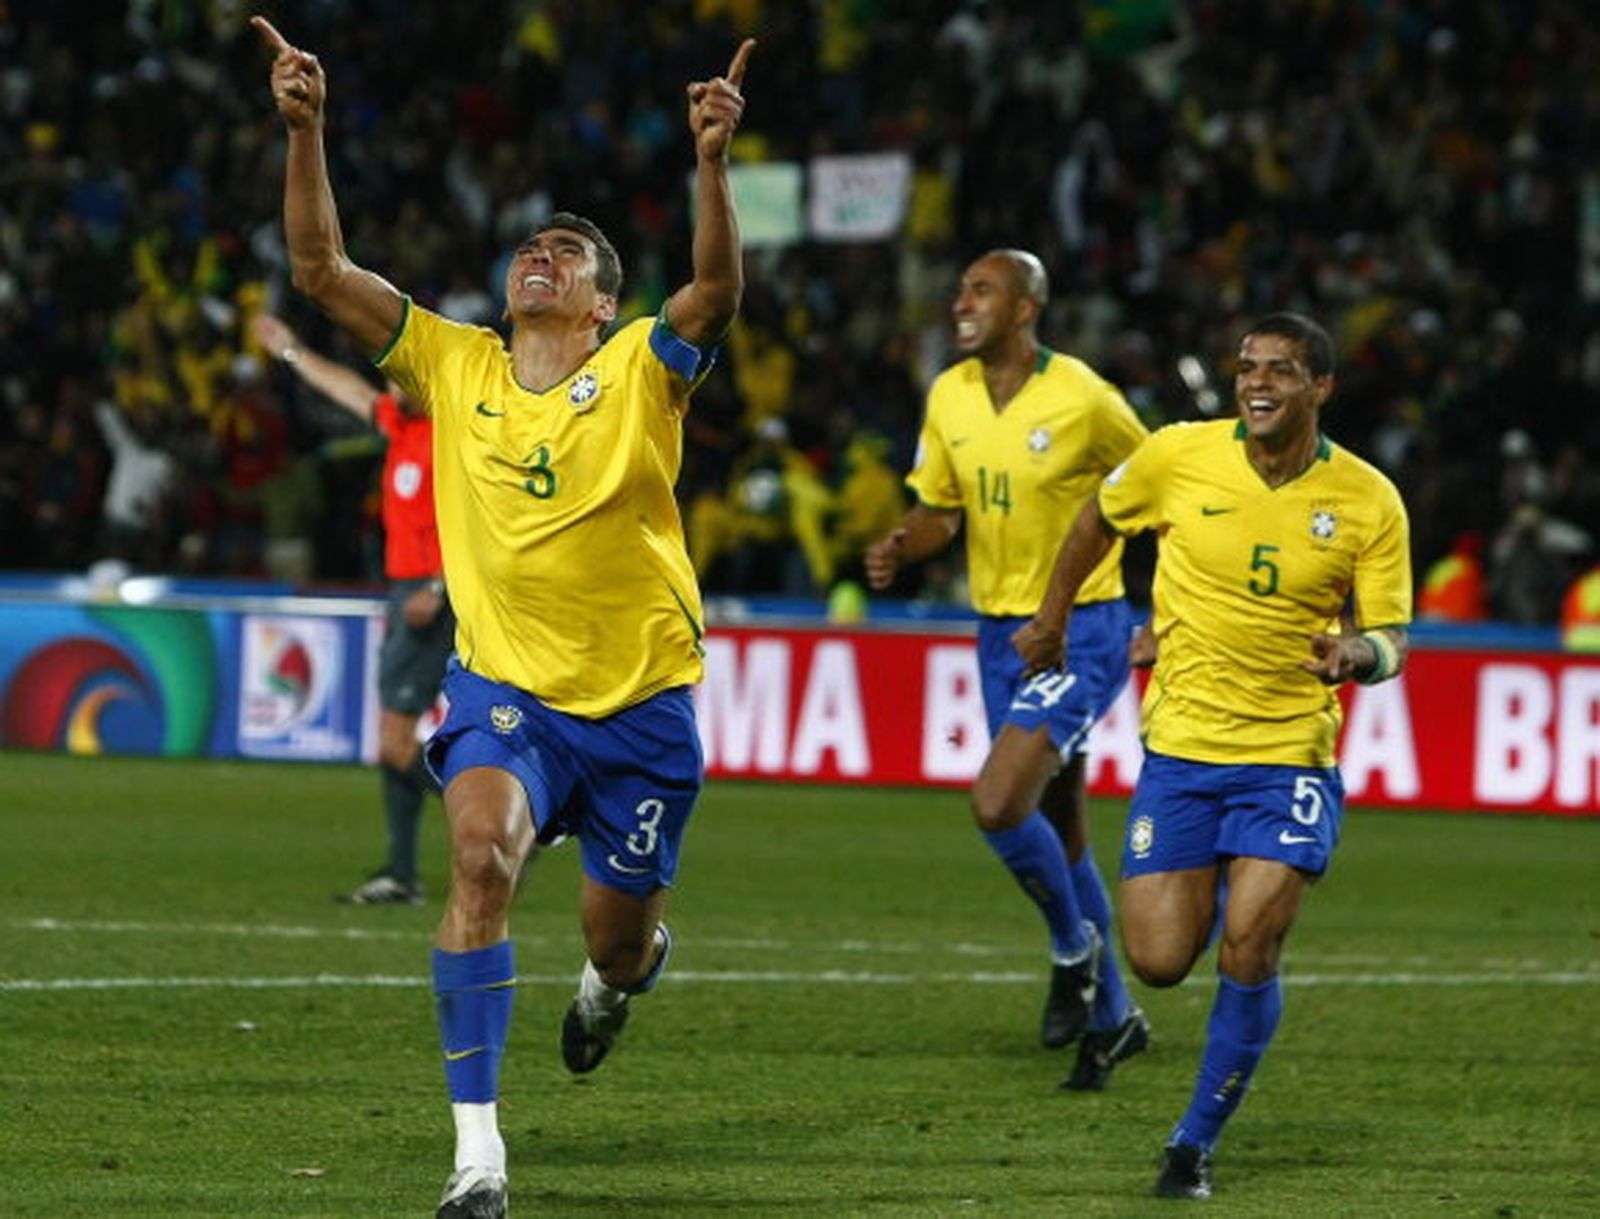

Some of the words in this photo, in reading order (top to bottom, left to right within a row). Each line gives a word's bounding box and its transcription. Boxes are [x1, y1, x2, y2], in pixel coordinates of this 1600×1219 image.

[523, 442, 557, 500] 3
[977, 466, 1012, 517] 14
[1247, 544, 1280, 597] 5
[1290, 775, 1323, 825] 5
[625, 799, 665, 856] 3
